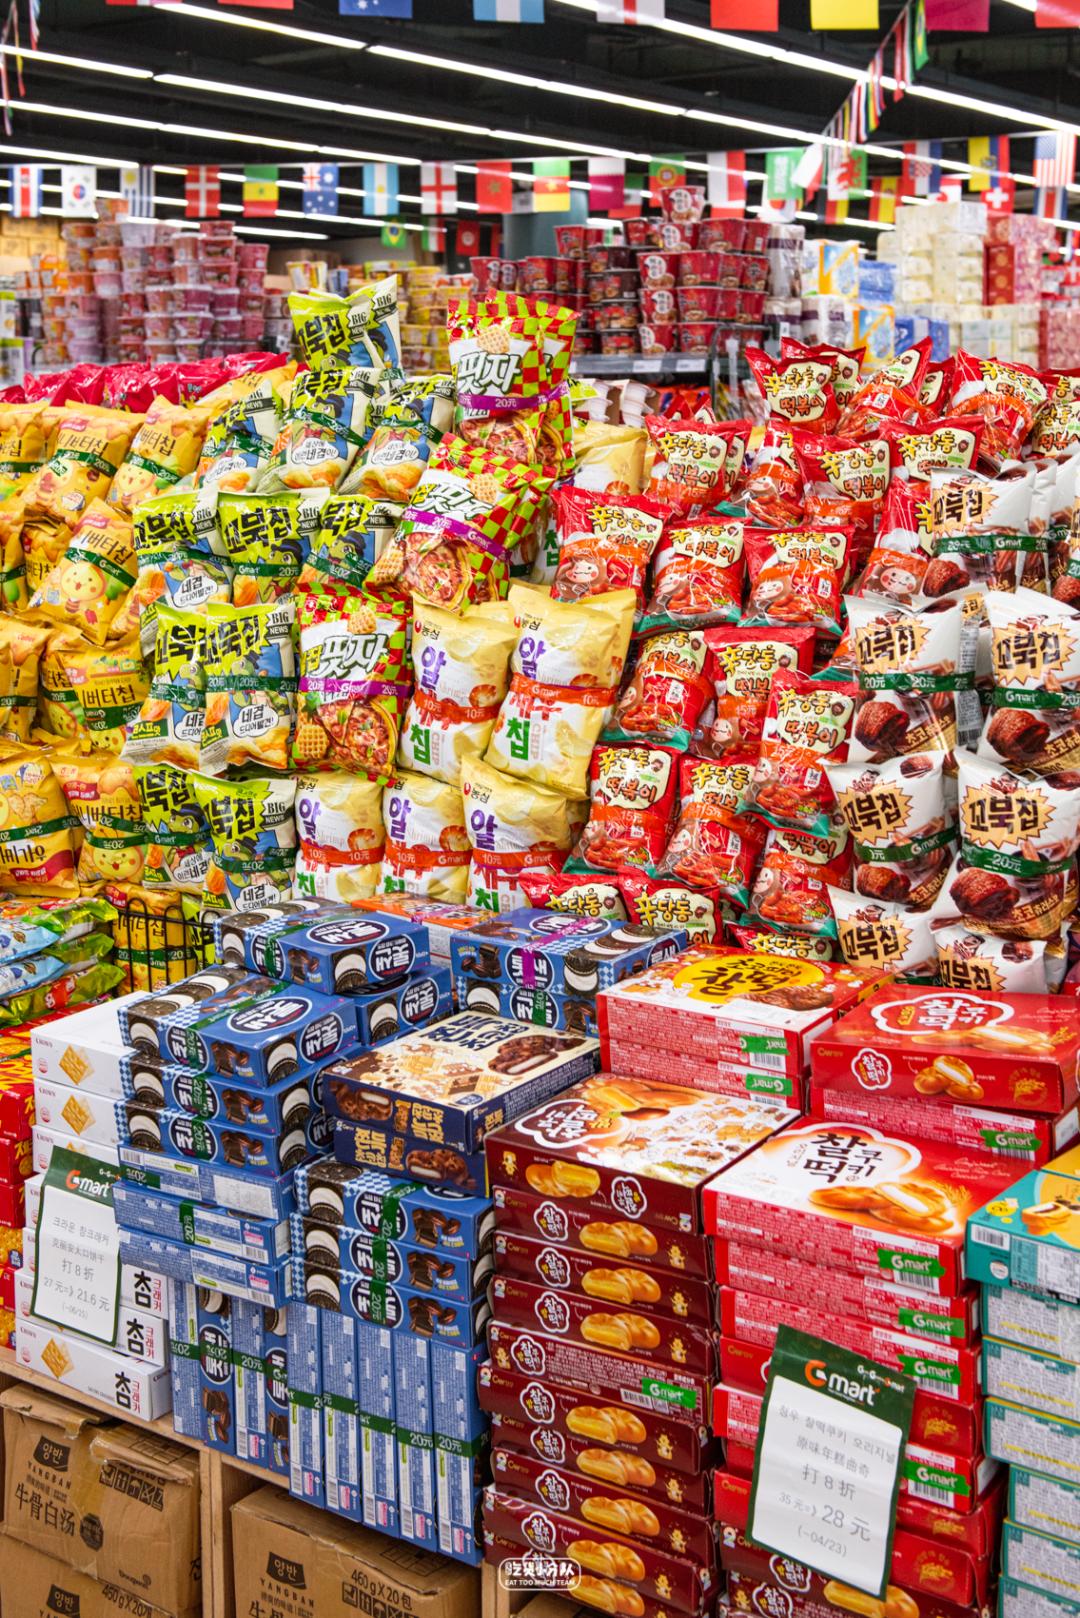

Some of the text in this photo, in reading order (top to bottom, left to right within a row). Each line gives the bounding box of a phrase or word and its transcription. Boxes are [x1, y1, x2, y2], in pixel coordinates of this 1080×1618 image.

[351, 310, 367, 327] BIG
[301, 506, 320, 519] BIG
[271, 610, 290, 624] BIG
[269, 625, 290, 637] NEWS
[1005, 689, 1036, 704] Gmart
[241, 704, 264, 725] 네겹
[410, 725, 431, 766] 칩
[506, 716, 530, 762] 칩
[267, 801, 286, 814] BIG
[968, 795, 1039, 834] 꼬북칩
[242, 883, 265, 902] 네겹
[995, 1133, 1034, 1147] Gmart
[891, 1252, 933, 1273] Gmart
[912, 1314, 954, 1332] Gmart
[913, 1360, 955, 1379] Gmart
[42, 1440, 64, 1467] 양반
[27, 1460, 73, 1491] YANGBAN
[916, 1467, 958, 1489] Gmart
[14, 1482, 76, 1537] 牛骨白汤
[273, 1558, 298, 1584] 양반
